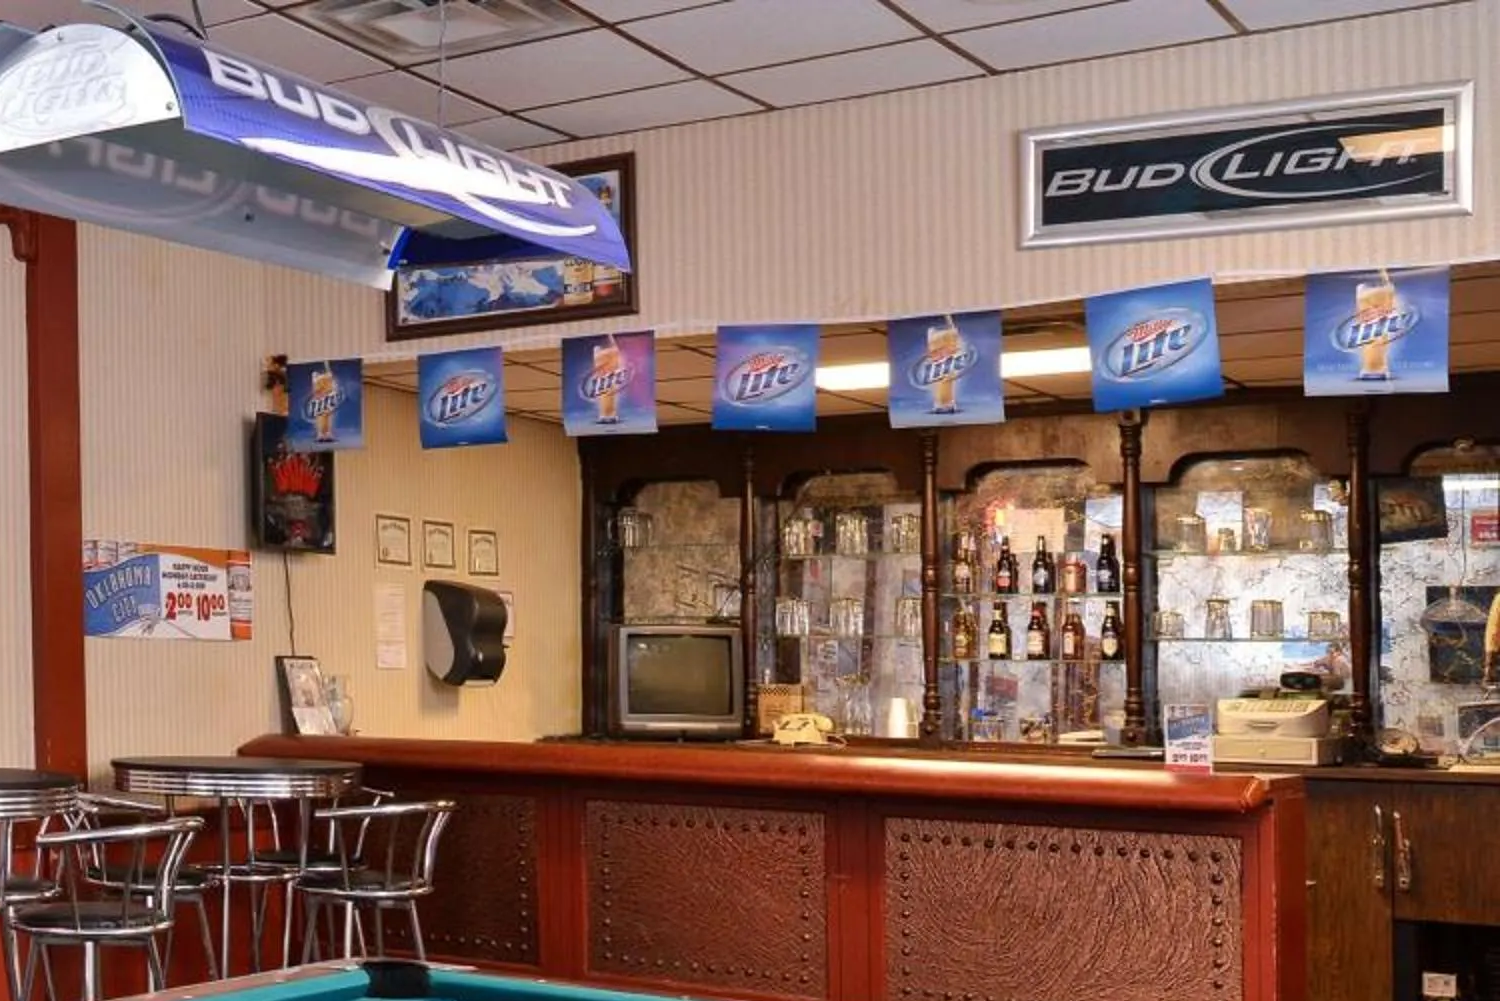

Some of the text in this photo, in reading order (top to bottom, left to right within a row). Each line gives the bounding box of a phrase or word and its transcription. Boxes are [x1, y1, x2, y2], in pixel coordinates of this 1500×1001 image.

[201, 47, 573, 209] BUD LIGHT
[1045, 137, 1436, 197] BUD LIGHT
[1121, 324, 1192, 377] Lite
[437, 383, 487, 421] Lite
[735, 363, 799, 401] Lite
